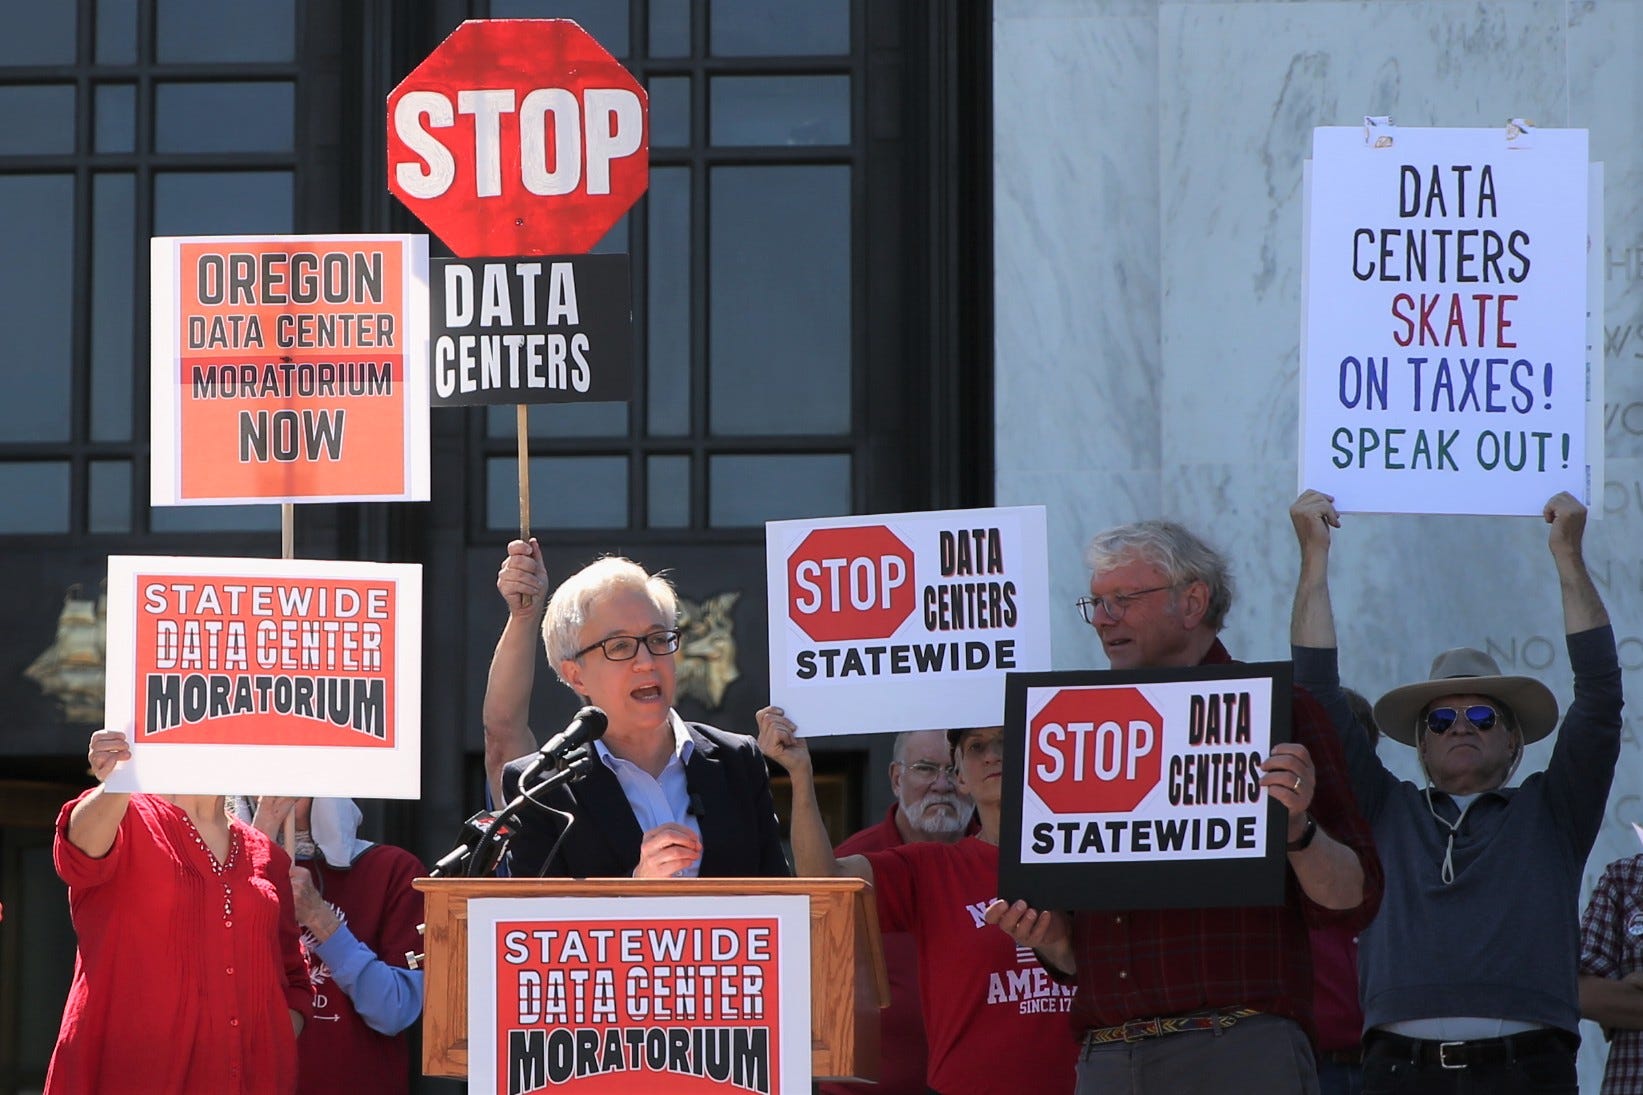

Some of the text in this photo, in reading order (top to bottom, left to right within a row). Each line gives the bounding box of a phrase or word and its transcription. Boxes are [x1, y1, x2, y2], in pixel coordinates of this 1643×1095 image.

[395, 88, 643, 199] STOP
[1399, 165, 1497, 218] DATA
[196, 252, 383, 305] OREGON
[1353, 228, 1530, 283] CENTERS
[445, 262, 578, 327] DATA
[1392, 293, 1518, 348] SKATE
[188, 312, 394, 350] DATA CENTER
[192, 362, 392, 400] MORATORIUM
[435, 333, 591, 399] CENTERS
[1339, 356, 1388, 410] ON
[1407, 358, 1553, 414] TAXES!
[238, 409, 345, 463] NOW
[1332, 427, 1570, 472] SPEAK OUT!
[940, 528, 1003, 577] DATA
[144, 583, 389, 619] STATEWIDE
[796, 555, 907, 614] STOP
[923, 581, 1017, 631] CENTERS
[156, 619, 382, 671] DATA CENTER
[796, 640, 1016, 680] STATEWIDE
[145, 673, 386, 740] MORATORIUM
[1189, 692, 1251, 745] DATA
[1037, 720, 1155, 783] STOP
[1168, 751, 1261, 806] CENTERS
[1031, 817, 1257, 854] STATEWIDE
[504, 928, 771, 965] STATEWIDE
[518, 965, 765, 1024] DATA CENTER
[1019, 998, 1072, 1014] SINCE 17
[506, 1027, 771, 1095] MORATORIUM
